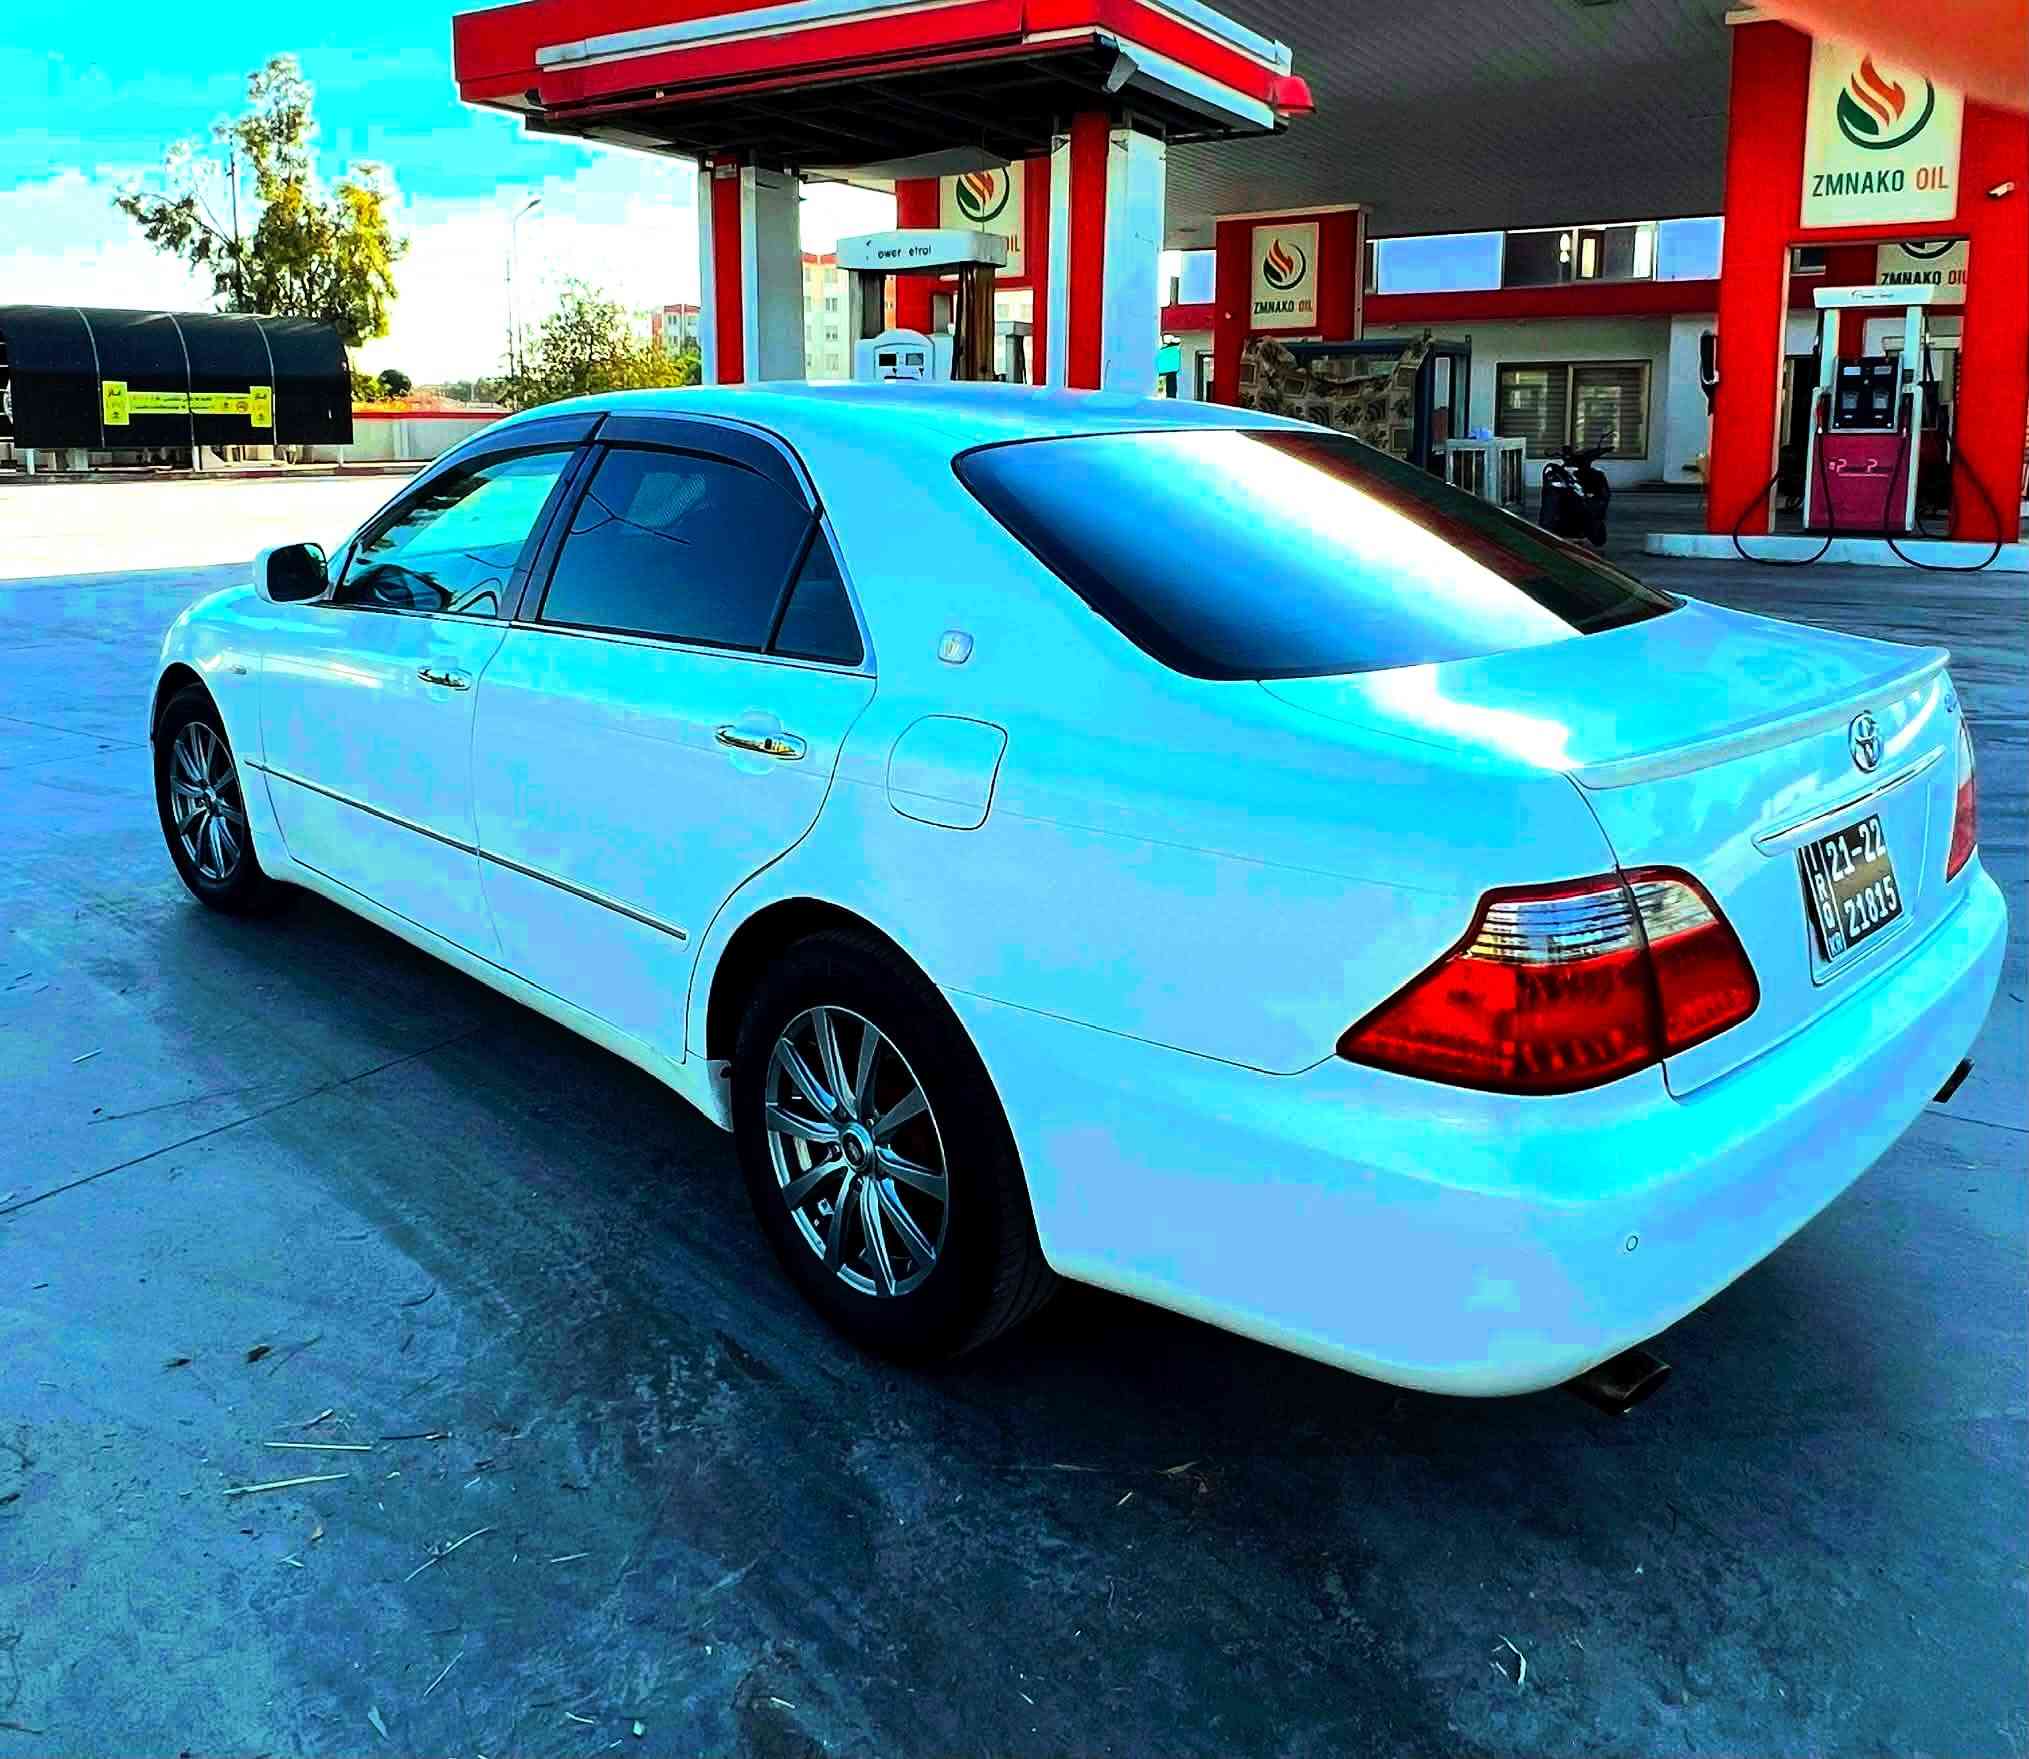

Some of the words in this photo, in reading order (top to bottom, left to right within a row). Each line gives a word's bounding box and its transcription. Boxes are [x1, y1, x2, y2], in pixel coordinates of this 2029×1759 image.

[1812, 169, 1905, 198] ZMNAKO
[1915, 166, 1949, 191] OIL
[1881, 270, 1942, 286] ZMNAKO
[1253, 300, 1295, 314] ZMNAKO
[1298, 299, 1313, 313] OIL
[1825, 818, 1887, 882] 21-22
[1843, 875, 1898, 938] 21815
